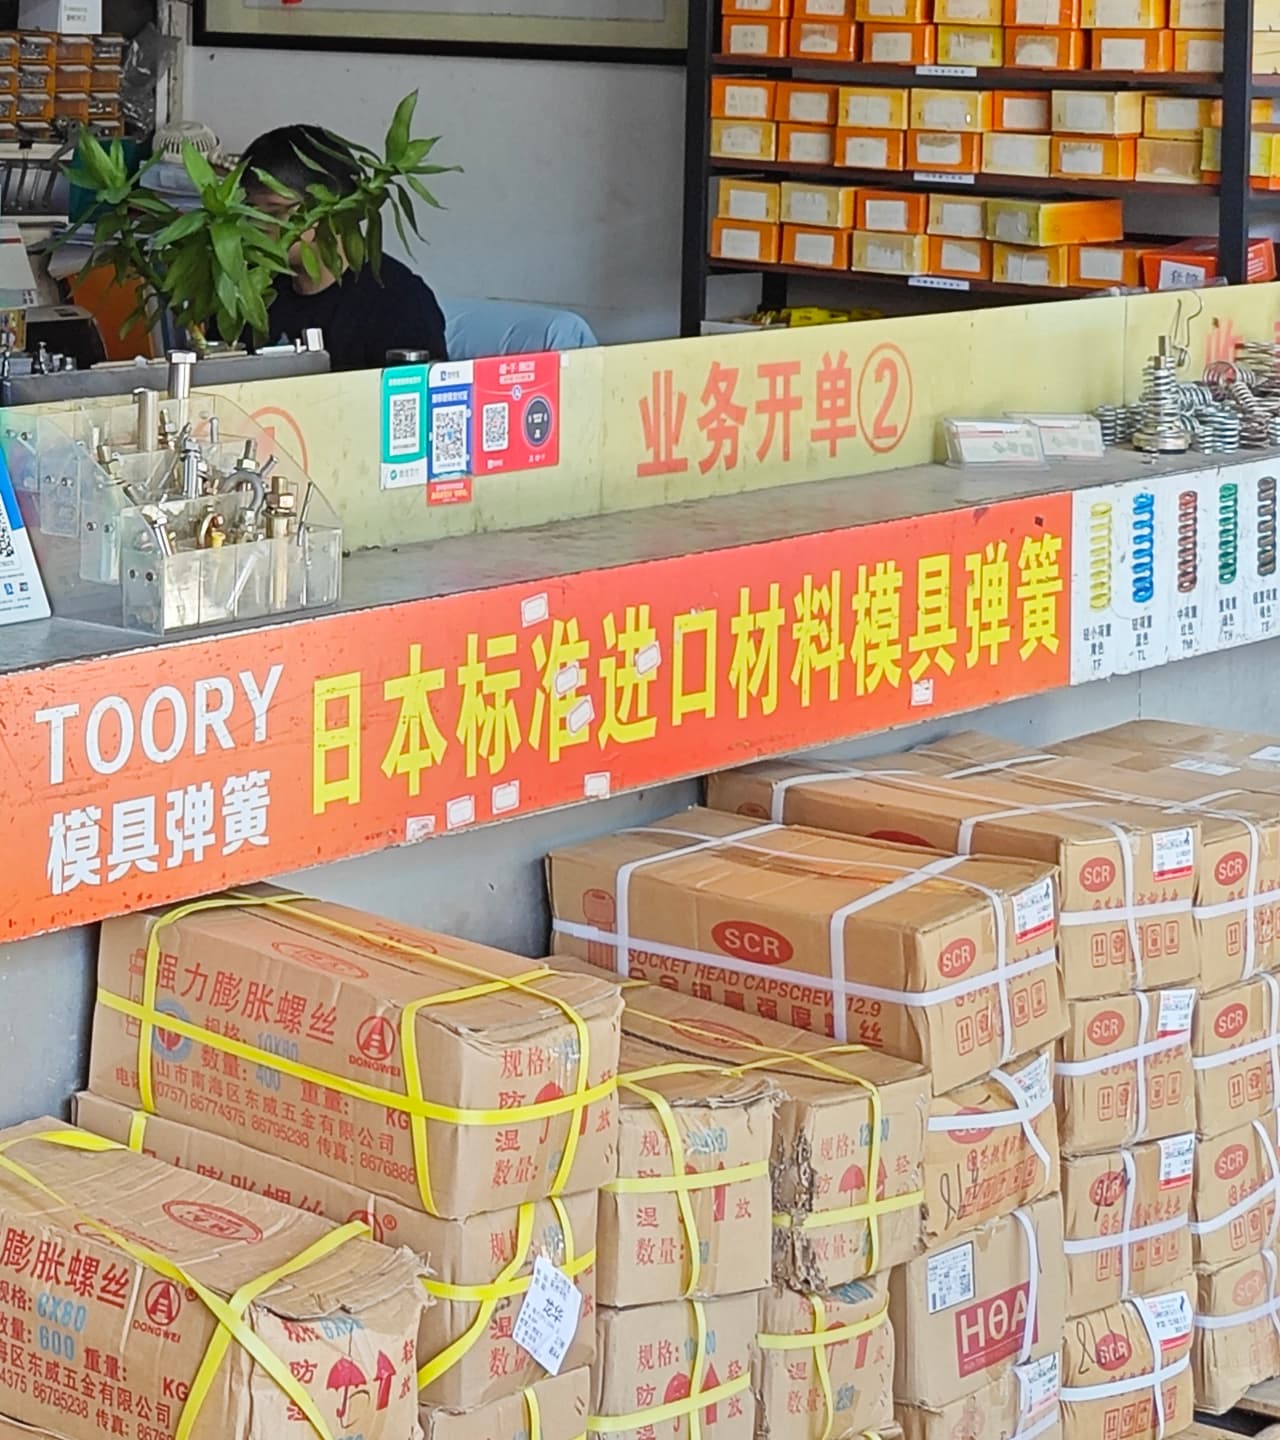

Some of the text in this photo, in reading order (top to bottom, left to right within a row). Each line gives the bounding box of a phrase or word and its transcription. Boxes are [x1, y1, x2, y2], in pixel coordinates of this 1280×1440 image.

[312, 532, 1064, 815] 日本标准进口材料模具弹簧
[35, 664, 284, 785] TOORY
[47, 770, 272, 896] 模具弹簧
[1083, 863, 1112, 885] SCR
[1218, 859, 1244, 880] SCR
[724, 927, 781, 958] SCR
[942, 945, 972, 971] SCR
[628, 947, 882, 1018] SOCKET HEAD CAPSCREW 12.9
[156, 952, 338, 1046] 强力膨胀螺丝
[1091, 1018, 1120, 1038] SCR
[1218, 1011, 1245, 1032] SCR
[348, 1054, 401, 1078] DONGWEI
[156, 1059, 394, 1156] 山市南海区东威五金有限公司
[386, 1107, 409, 1131] KG
[491, 1157, 539, 1189] 数量:
[1218, 1150, 1246, 1174] SCR
[133, 1319, 182, 1344] DONGWEI
[83, 1346, 129, 1383] 重量:
[32, 1380, 90, 1420] 86795238
[162, 1376, 189, 1403] KG
